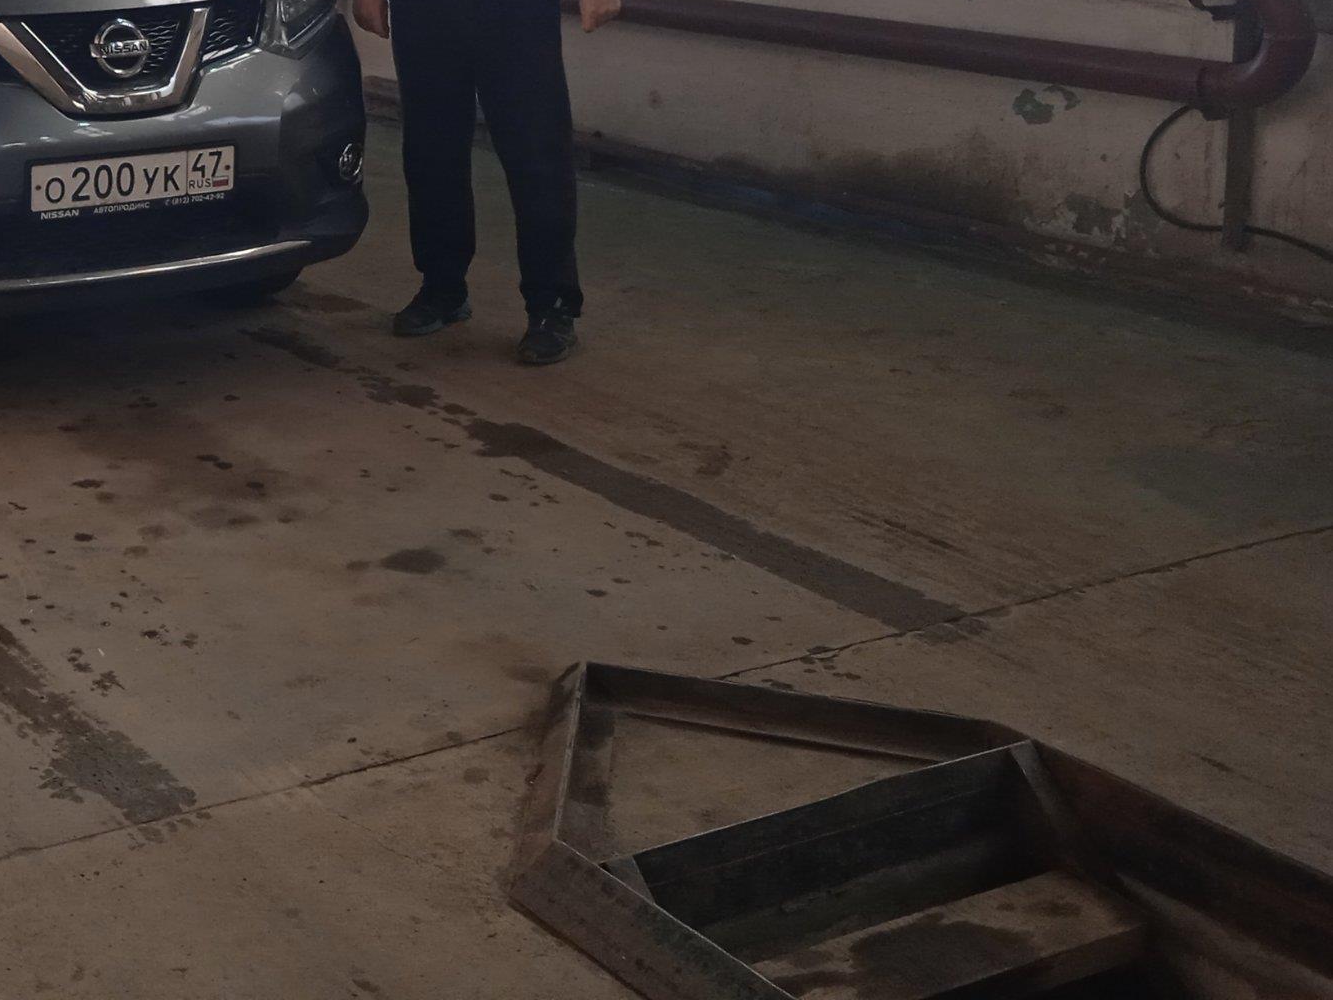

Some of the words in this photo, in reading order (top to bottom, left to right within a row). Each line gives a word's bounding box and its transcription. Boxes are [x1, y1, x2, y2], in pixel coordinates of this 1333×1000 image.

[100, 41, 148, 55] NISSAN
[191, 151, 223, 179] 47
[189, 178, 212, 189] RUS
[40, 209, 80, 220] NISSAN
